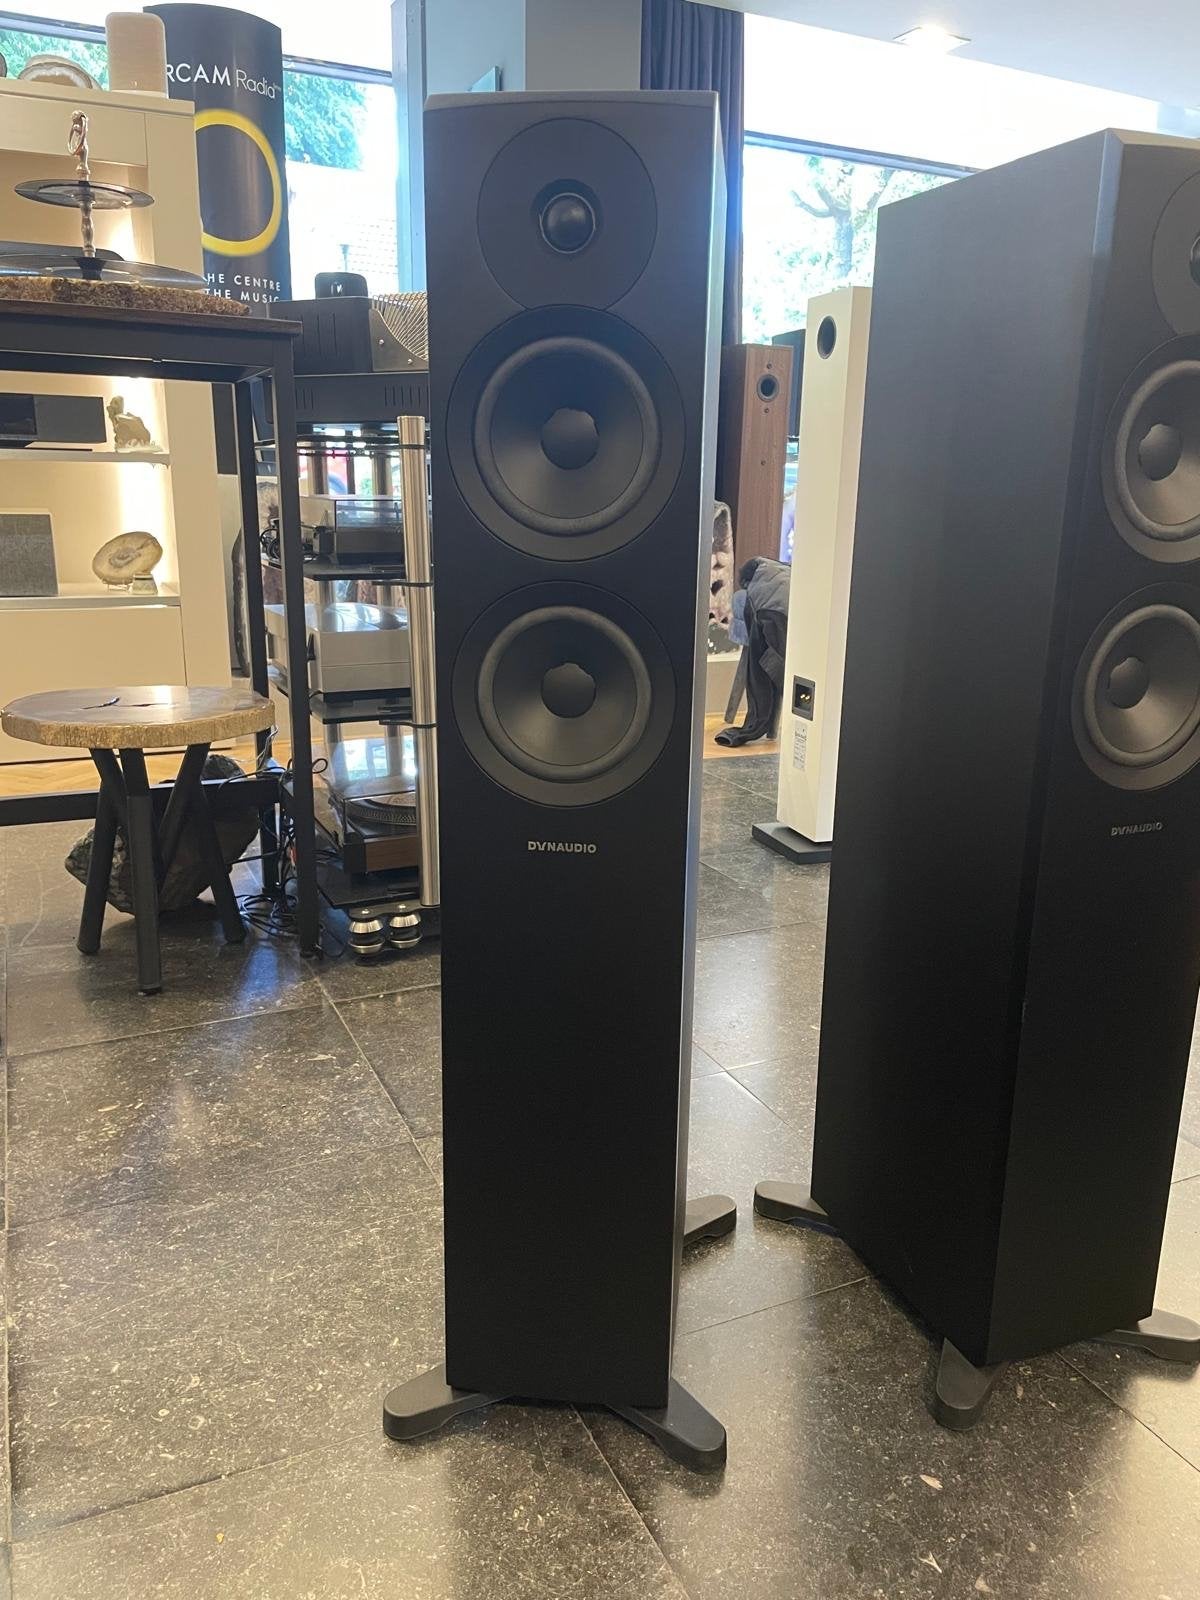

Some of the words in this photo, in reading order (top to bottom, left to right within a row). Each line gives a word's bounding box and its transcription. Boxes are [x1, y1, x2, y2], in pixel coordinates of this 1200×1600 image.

[166, 63, 231, 86] RCAM
[236, 69, 276, 99] Radia
[207, 273, 225, 284] HE
[233, 275, 281, 291] CENTRE
[527, 840, 597, 854] DYNAUDIO
